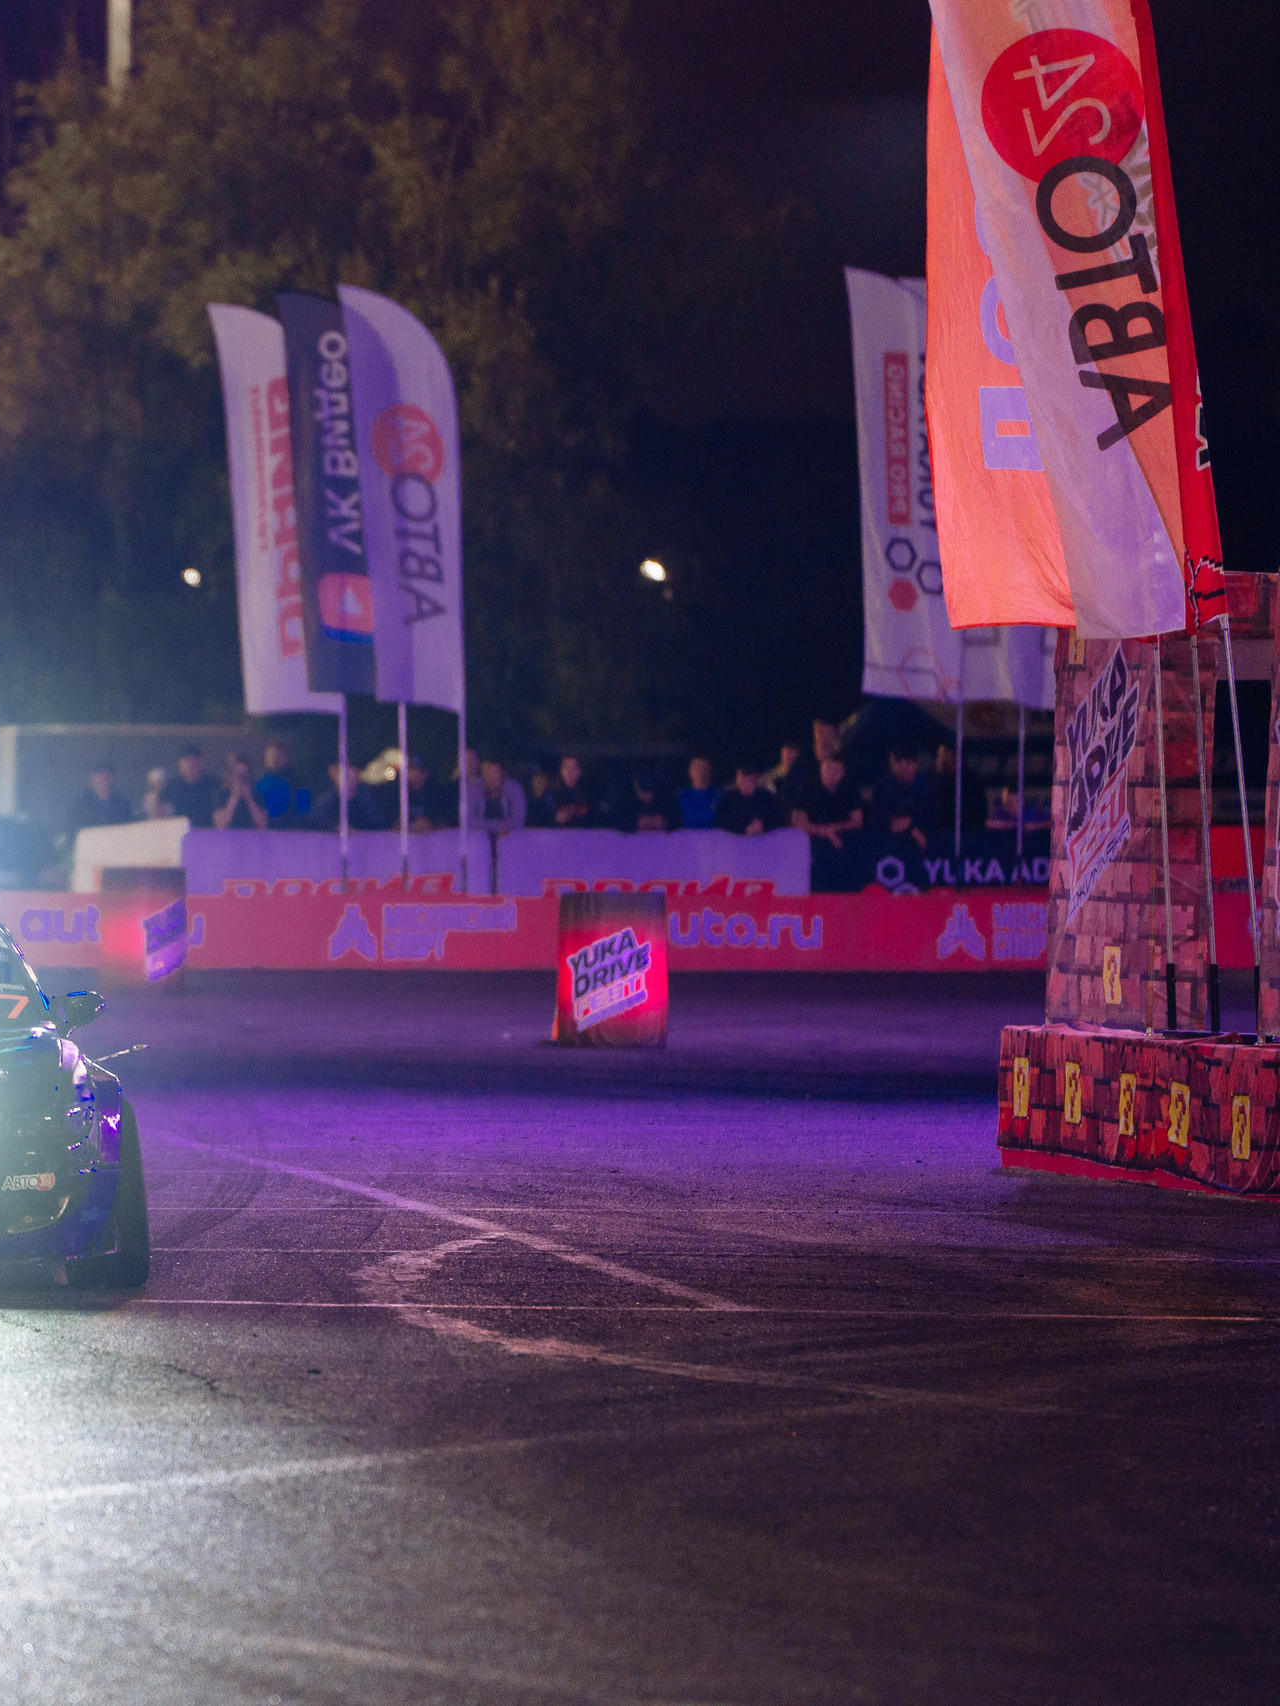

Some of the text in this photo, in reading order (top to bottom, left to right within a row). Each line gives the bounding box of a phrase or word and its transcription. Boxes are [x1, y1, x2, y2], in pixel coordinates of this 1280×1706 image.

[667, 907, 824, 949] uto.ru
[568, 931, 635, 975] YUKA
[574, 946, 649, 999] DRIVE
